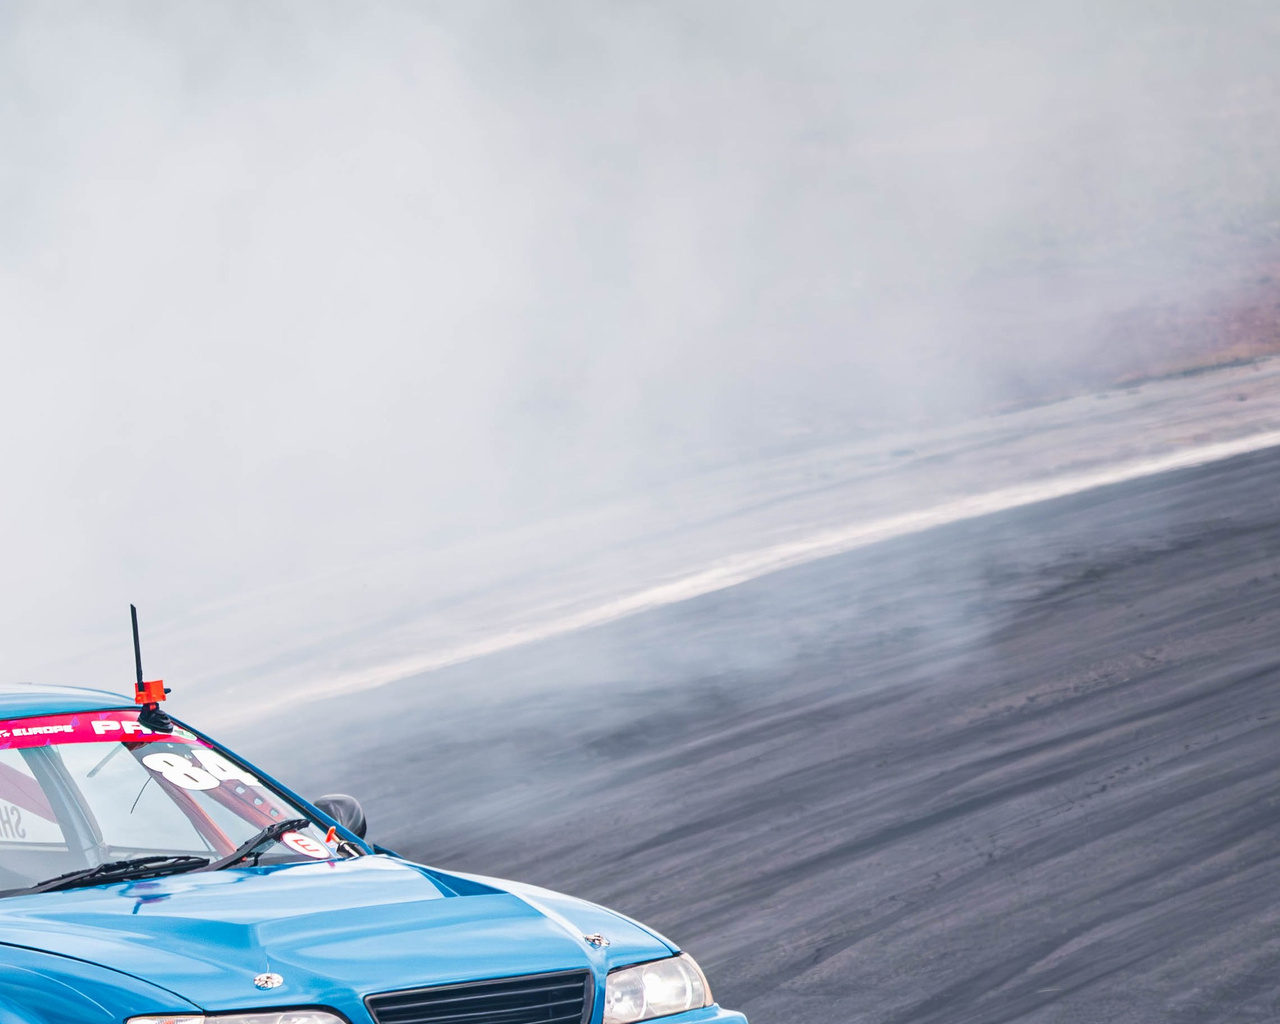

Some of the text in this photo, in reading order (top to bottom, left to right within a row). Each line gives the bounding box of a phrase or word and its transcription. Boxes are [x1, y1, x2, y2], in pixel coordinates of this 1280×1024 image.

[12, 724, 74, 738] EUROPE
[91, 720, 168, 736] PR
[142, 749, 267, 791] 84
